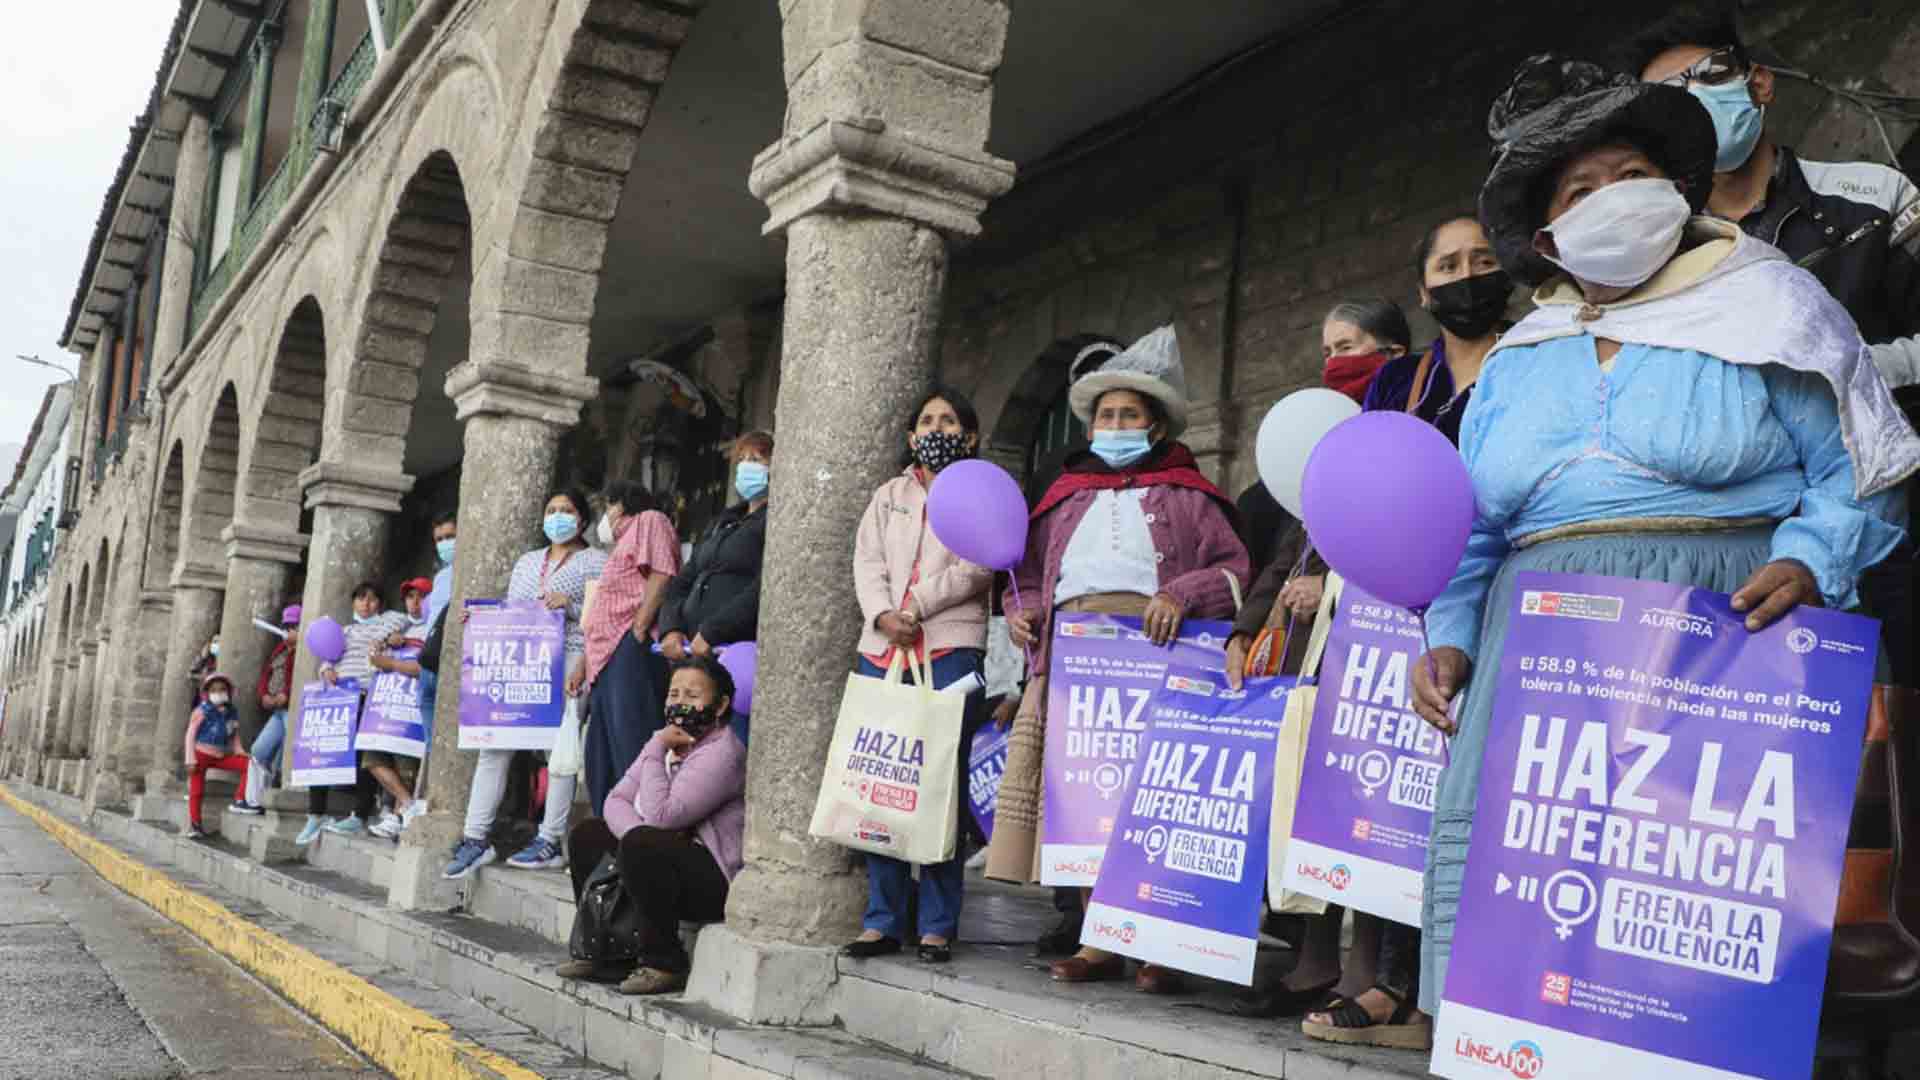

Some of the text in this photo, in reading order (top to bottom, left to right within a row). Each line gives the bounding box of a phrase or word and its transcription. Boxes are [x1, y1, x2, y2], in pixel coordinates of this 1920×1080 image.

[1640, 613, 1713, 638] AURORA
[472, 665, 552, 681] DIFERENCIA
[473, 640, 552, 665] HAZ LA
[1340, 643, 1413, 710] HA
[1520, 656, 1841, 715] El 58.9 % de la población en el Perú
[304, 706, 350, 722] HAZ LA
[1068, 684, 1152, 730] HAZ
[1521, 676, 1832, 734] tolera la violencia hacia las mujeres
[854, 727, 923, 766] HAZ LA
[1066, 731, 1140, 759] DIFER
[1332, 700, 1441, 756] DIFERE
[848, 755, 920, 786] DIFERENCIA
[1140, 741, 1257, 802] HAZ LA
[1401, 762, 1437, 786] FRE
[1512, 714, 1796, 839] HAZ LA
[1132, 788, 1249, 835] DIFERENCIA
[1172, 851, 1236, 878] VIOLENCIA
[1174, 832, 1239, 860] FRENA LA
[1503, 799, 1787, 899] DIFERENCIA
[1615, 887, 1765, 944] FRENA LA
[1613, 919, 1761, 975] VIOLENCIA
[1545, 975, 1566, 992] 25
